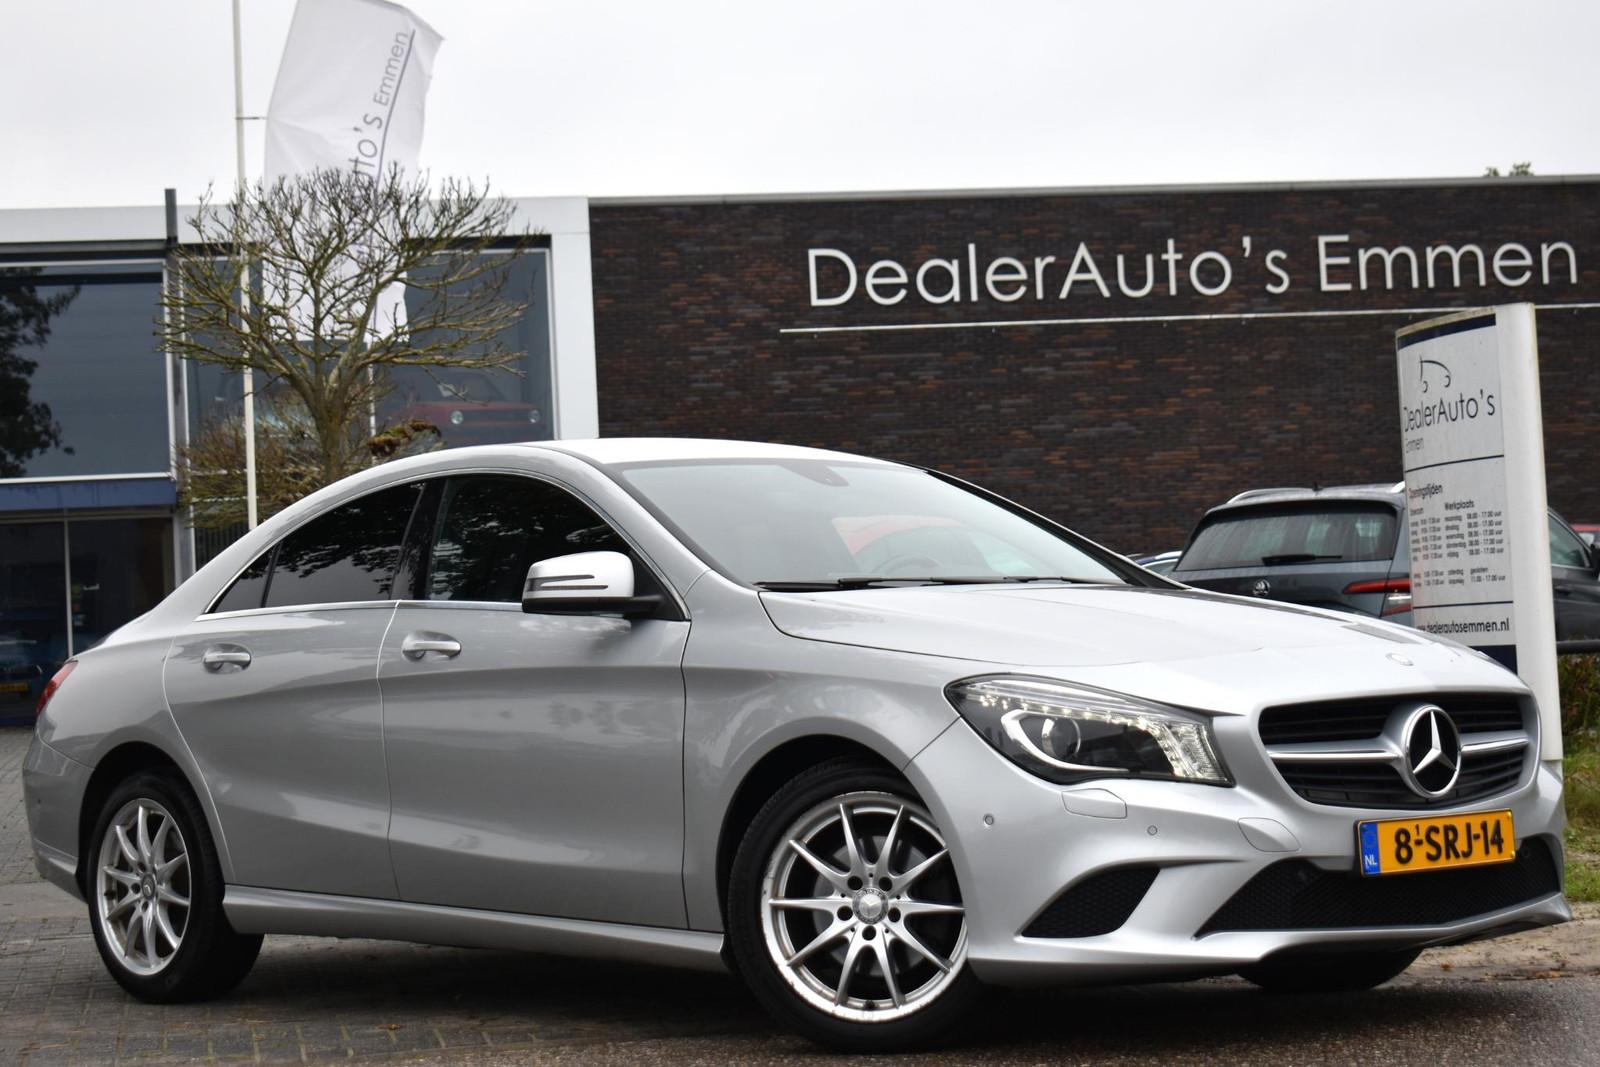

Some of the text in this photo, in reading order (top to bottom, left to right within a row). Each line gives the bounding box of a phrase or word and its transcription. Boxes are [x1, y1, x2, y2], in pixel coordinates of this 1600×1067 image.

[373, 31, 409, 107] Emmen
[806, 233, 1579, 308] DealerAuto's Emmen
[1403, 388, 1495, 432] DealerAuto's
[1364, 853, 1377, 868] NL
